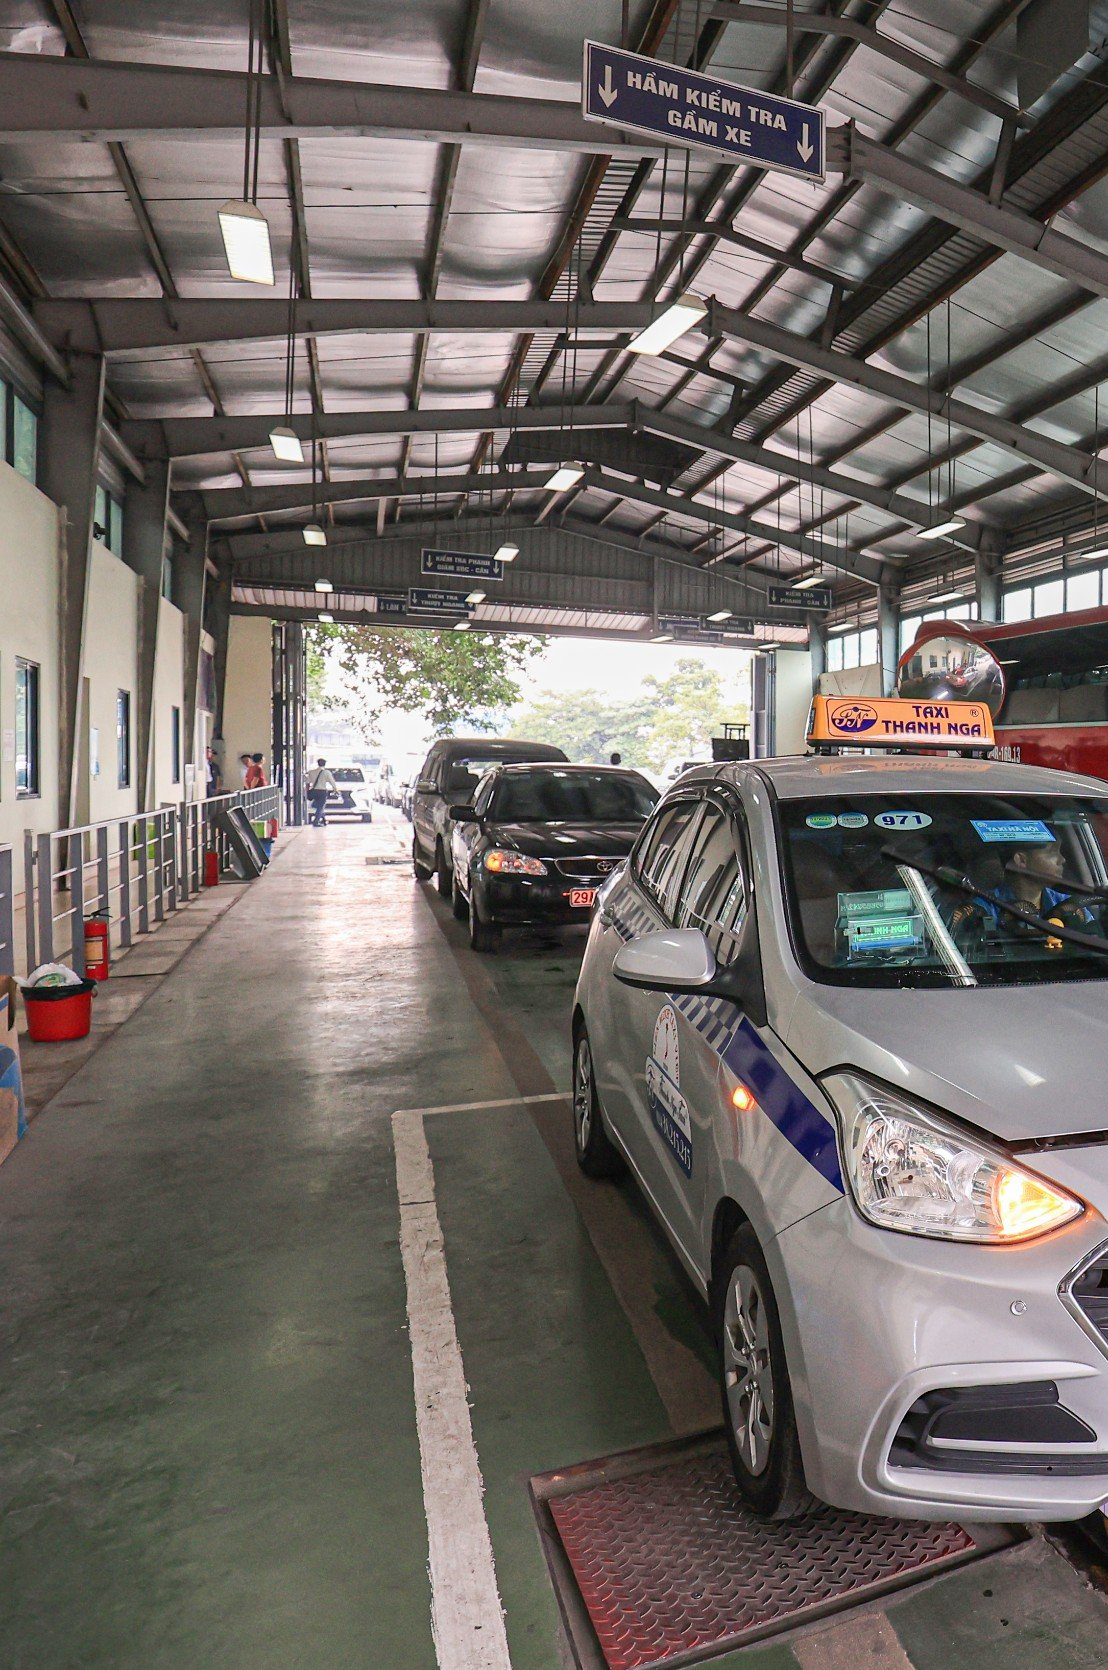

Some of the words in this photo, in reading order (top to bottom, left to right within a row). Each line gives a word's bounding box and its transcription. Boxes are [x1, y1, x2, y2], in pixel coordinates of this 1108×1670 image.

[626, 71, 678, 100] HẦM
[685, 89, 741, 118] KIỂM
[748, 105, 787, 131] TRA
[667, 109, 717, 138] GẦM
[725, 125, 752, 147] XE
[912, 705, 949, 719] TAXI
[881, 720, 943, 735] THANH
[948, 722, 981, 737] NGA
[881, 814, 923, 826] 971
